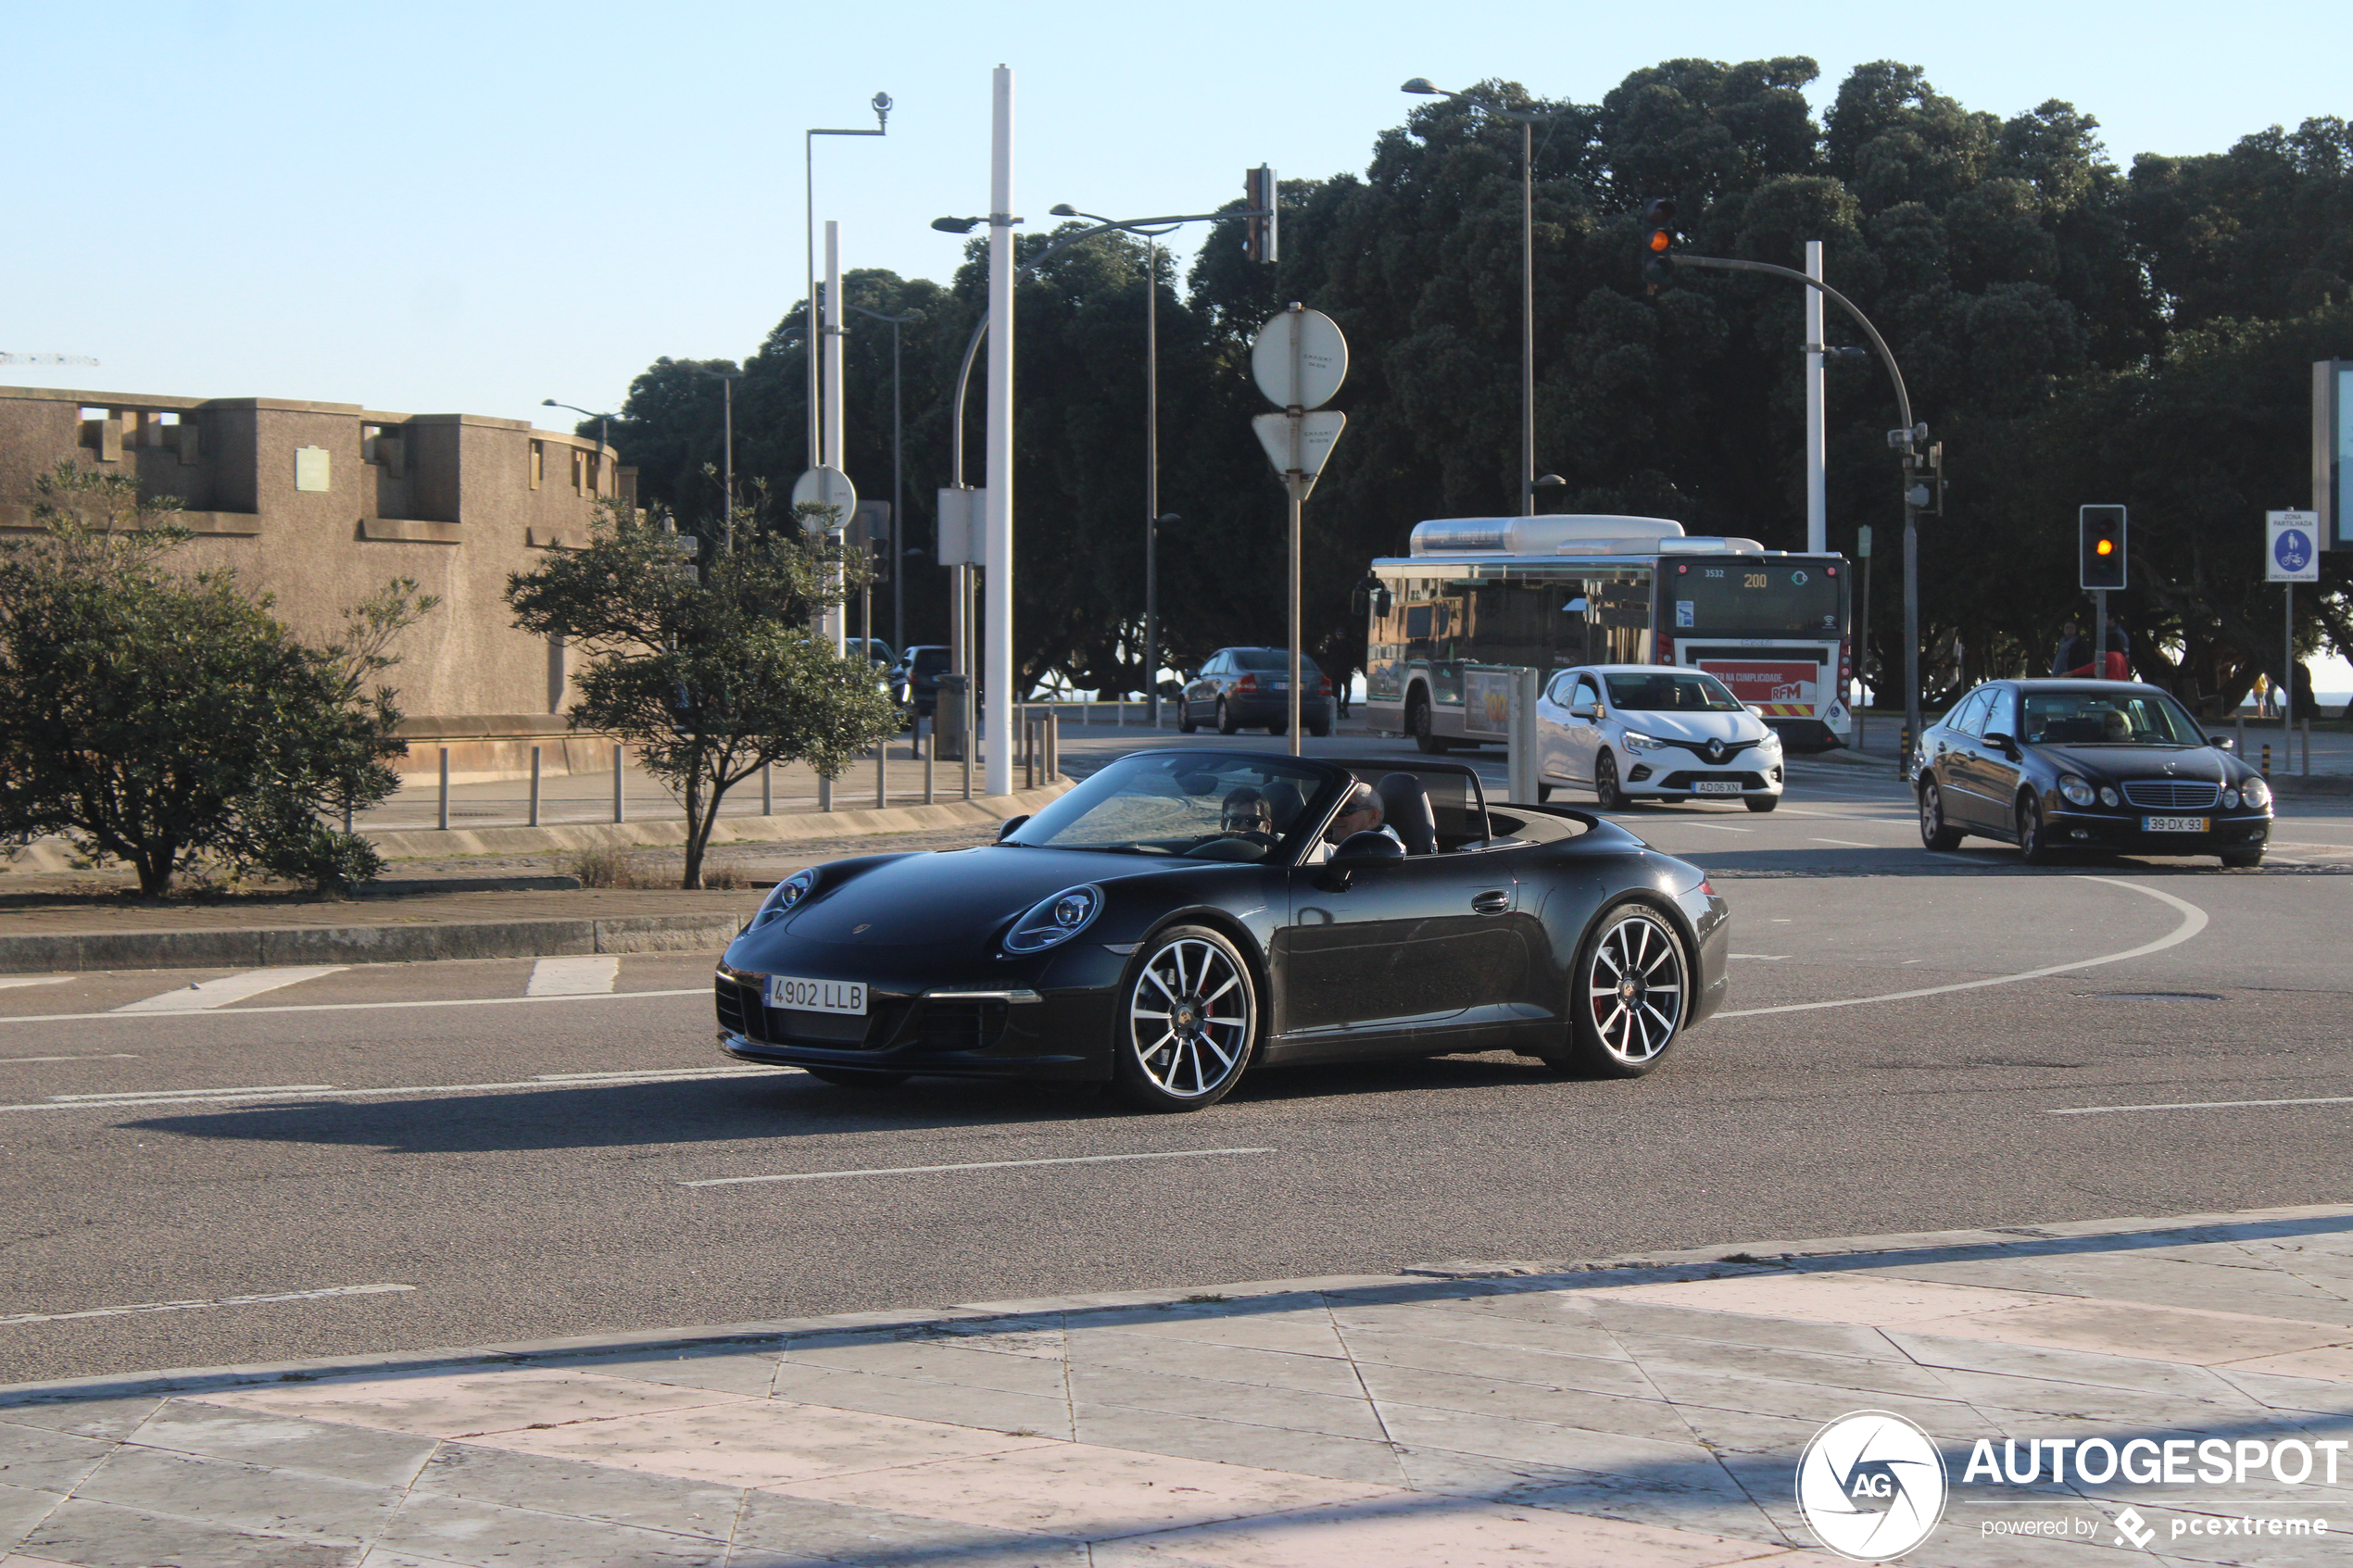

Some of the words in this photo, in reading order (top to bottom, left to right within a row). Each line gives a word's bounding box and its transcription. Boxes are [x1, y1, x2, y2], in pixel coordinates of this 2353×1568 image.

[1705, 570, 1724, 578] 3532
[1744, 574, 1768, 588] 200
[1726, 672, 1735, 682] NA
[1736, 672, 1784, 683] CUMPLICIDADE.
[1773, 684, 1801, 699] RFM
[774, 980, 817, 1007] 4902
[824, 984, 862, 1010] LLB
